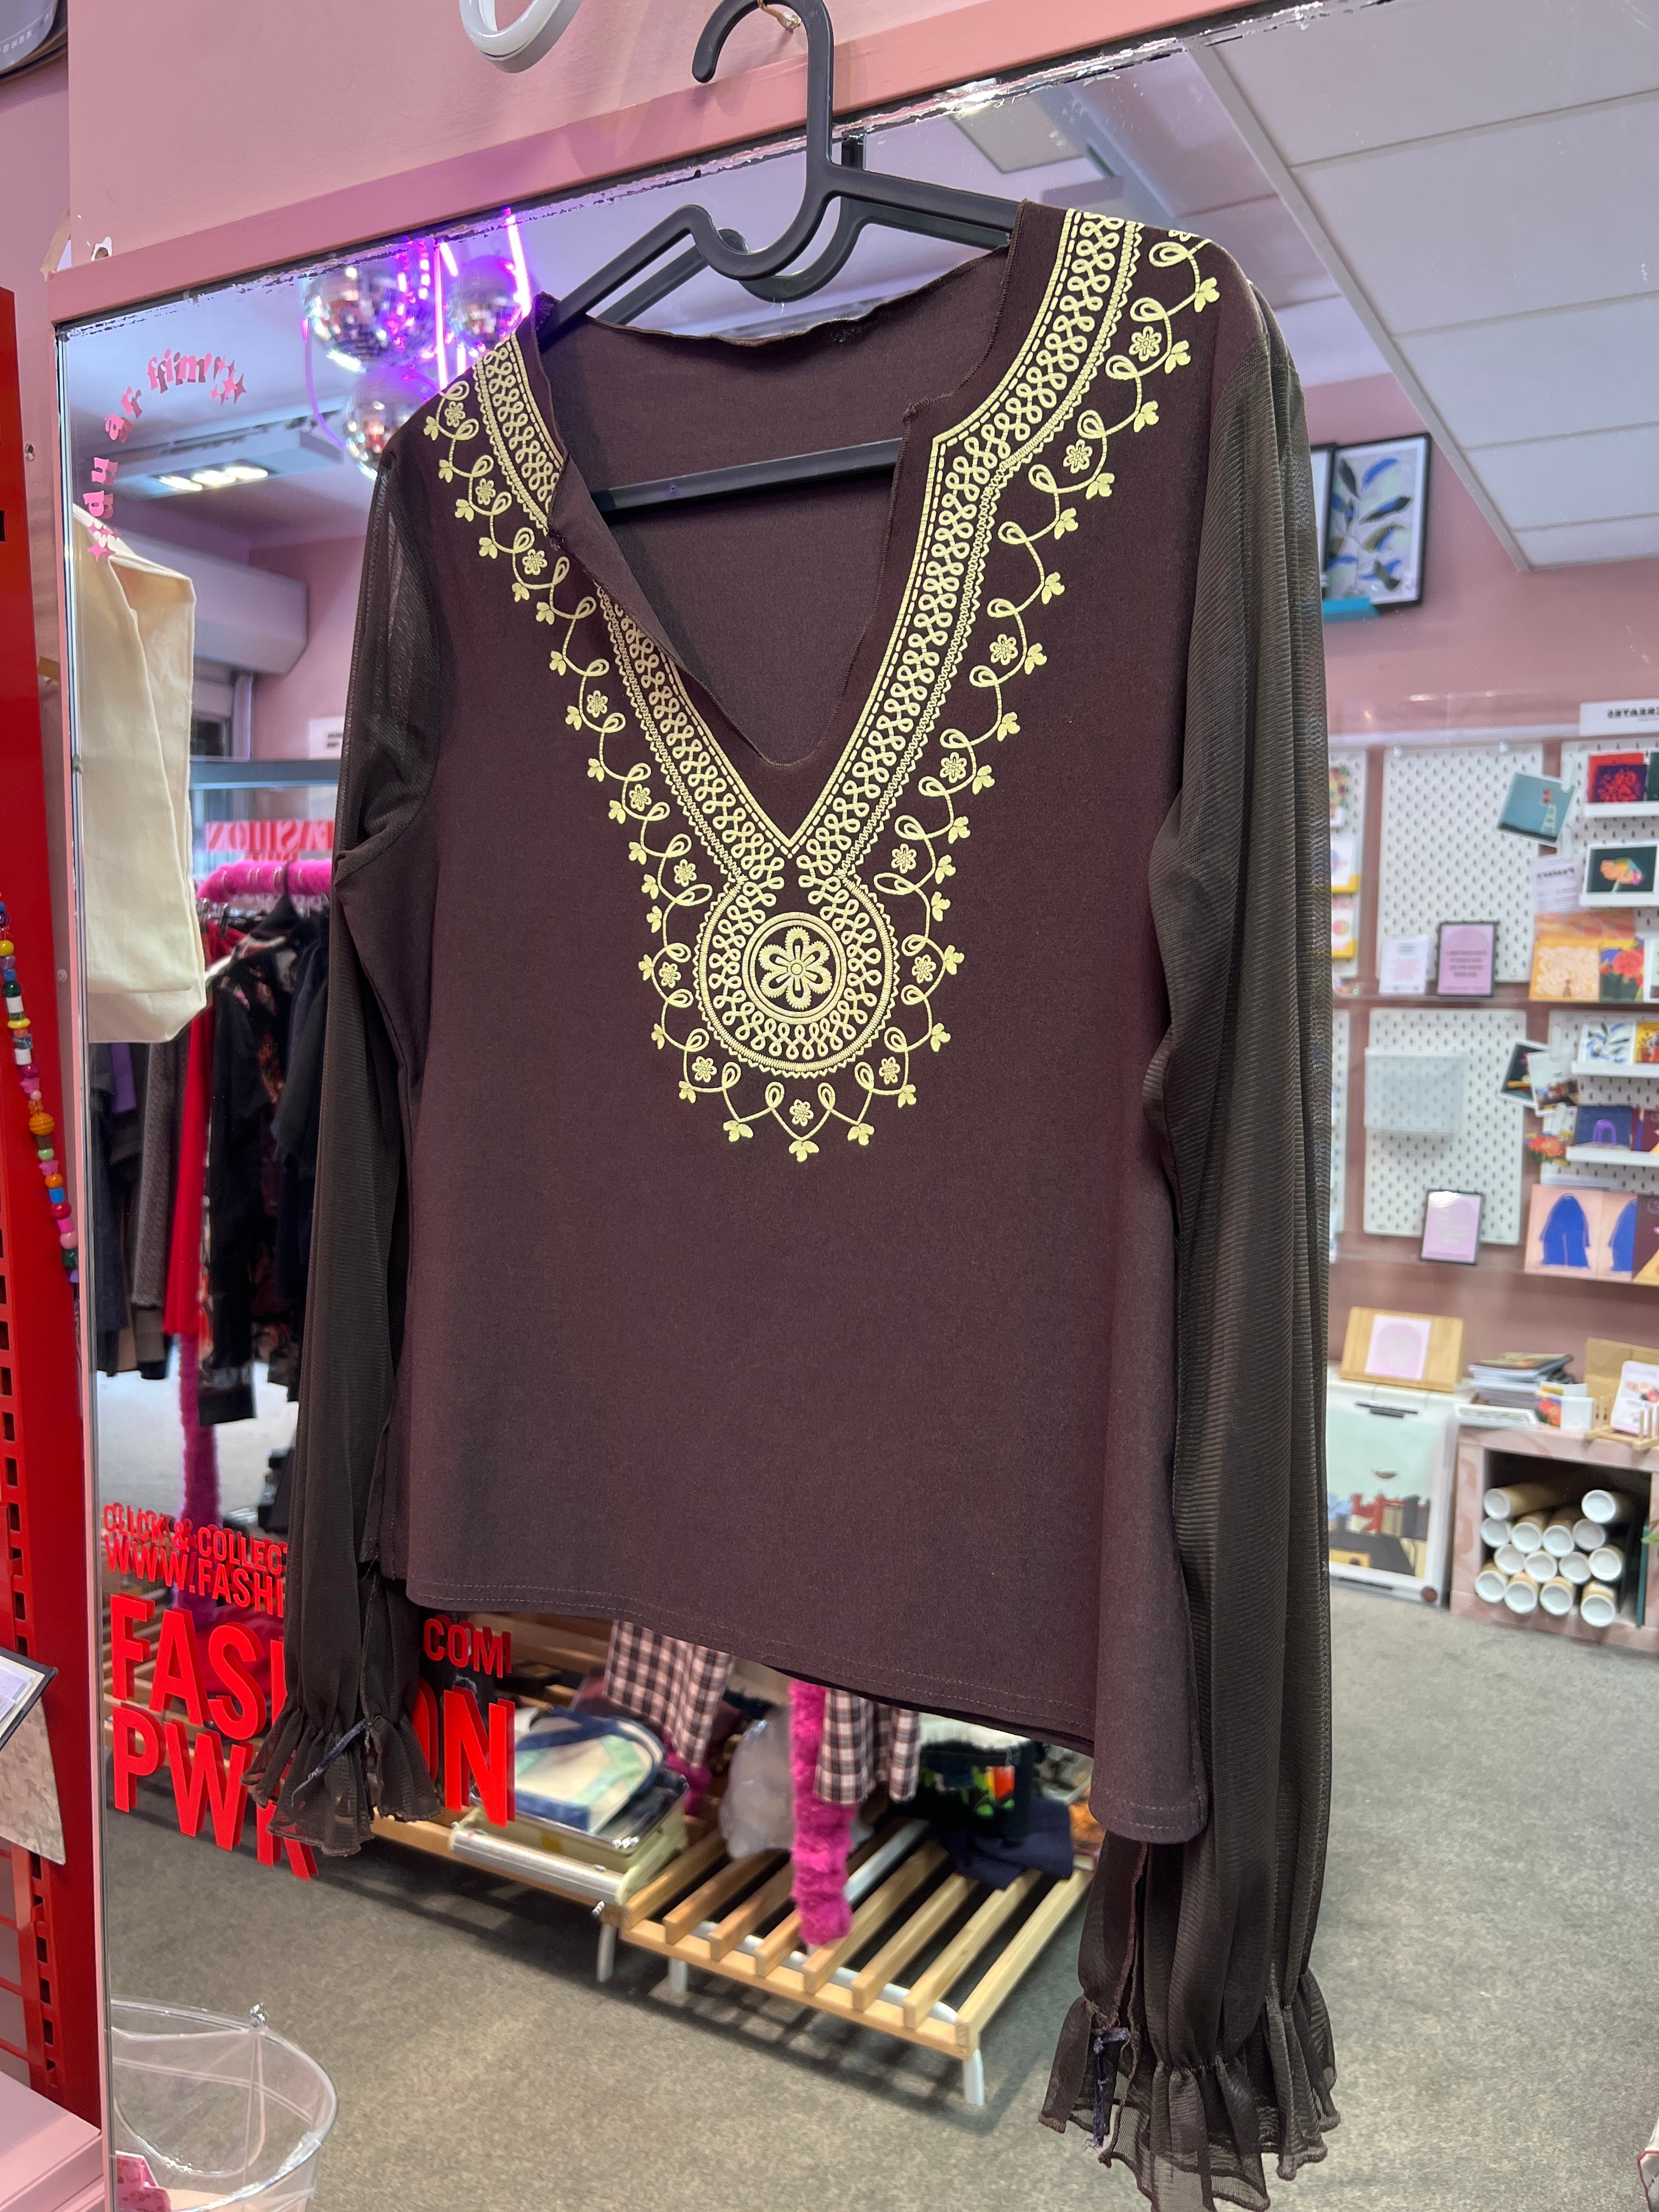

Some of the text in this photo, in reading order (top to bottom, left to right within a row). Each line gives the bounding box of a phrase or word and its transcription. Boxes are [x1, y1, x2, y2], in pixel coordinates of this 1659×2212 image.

[103, 1504, 288, 1576] CLICK & COLLEC
